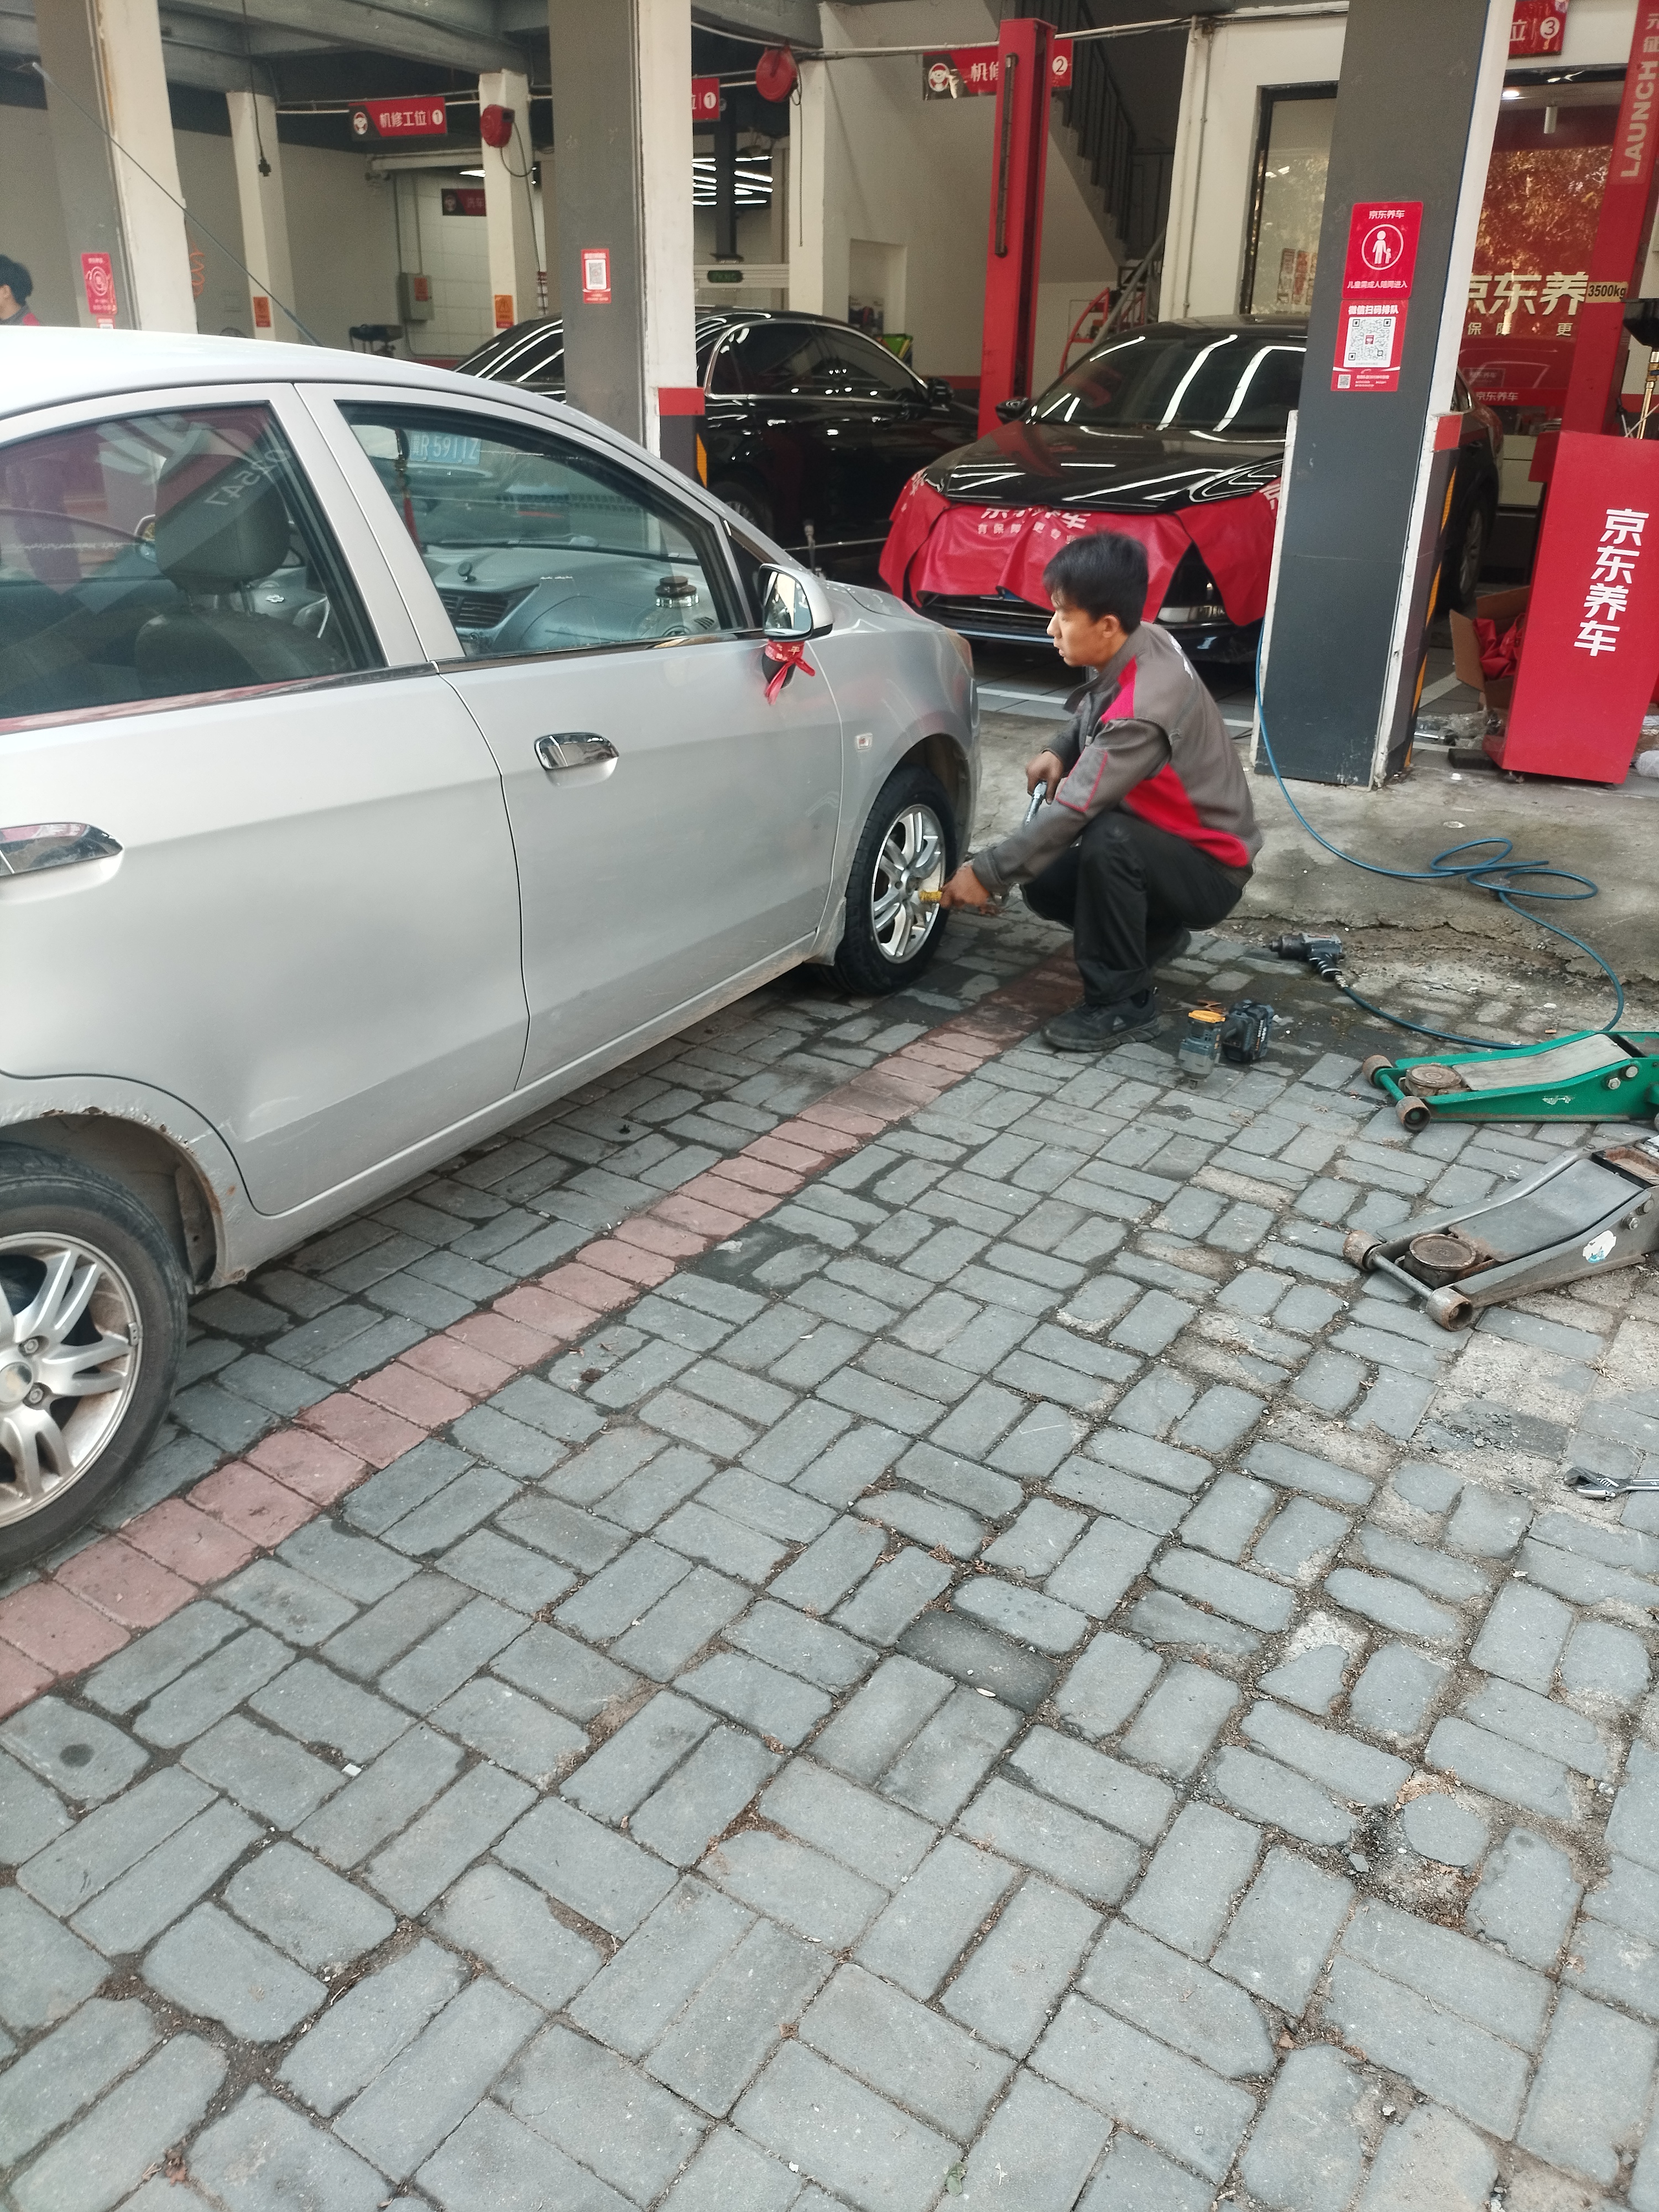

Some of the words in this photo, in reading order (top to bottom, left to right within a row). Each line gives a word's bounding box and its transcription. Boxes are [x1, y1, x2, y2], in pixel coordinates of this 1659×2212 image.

[379, 111, 427, 128] 机修工位
[1620, 60, 1659, 177] LAUNCH
[1369, 210, 1405, 219] 京东养车
[1588, 285, 1626, 299] 3500kg
[1556, 322, 1573, 337] 更
[1476, 392, 1519, 401] 京东养车
[1573, 508, 1649, 656] 京东养车
